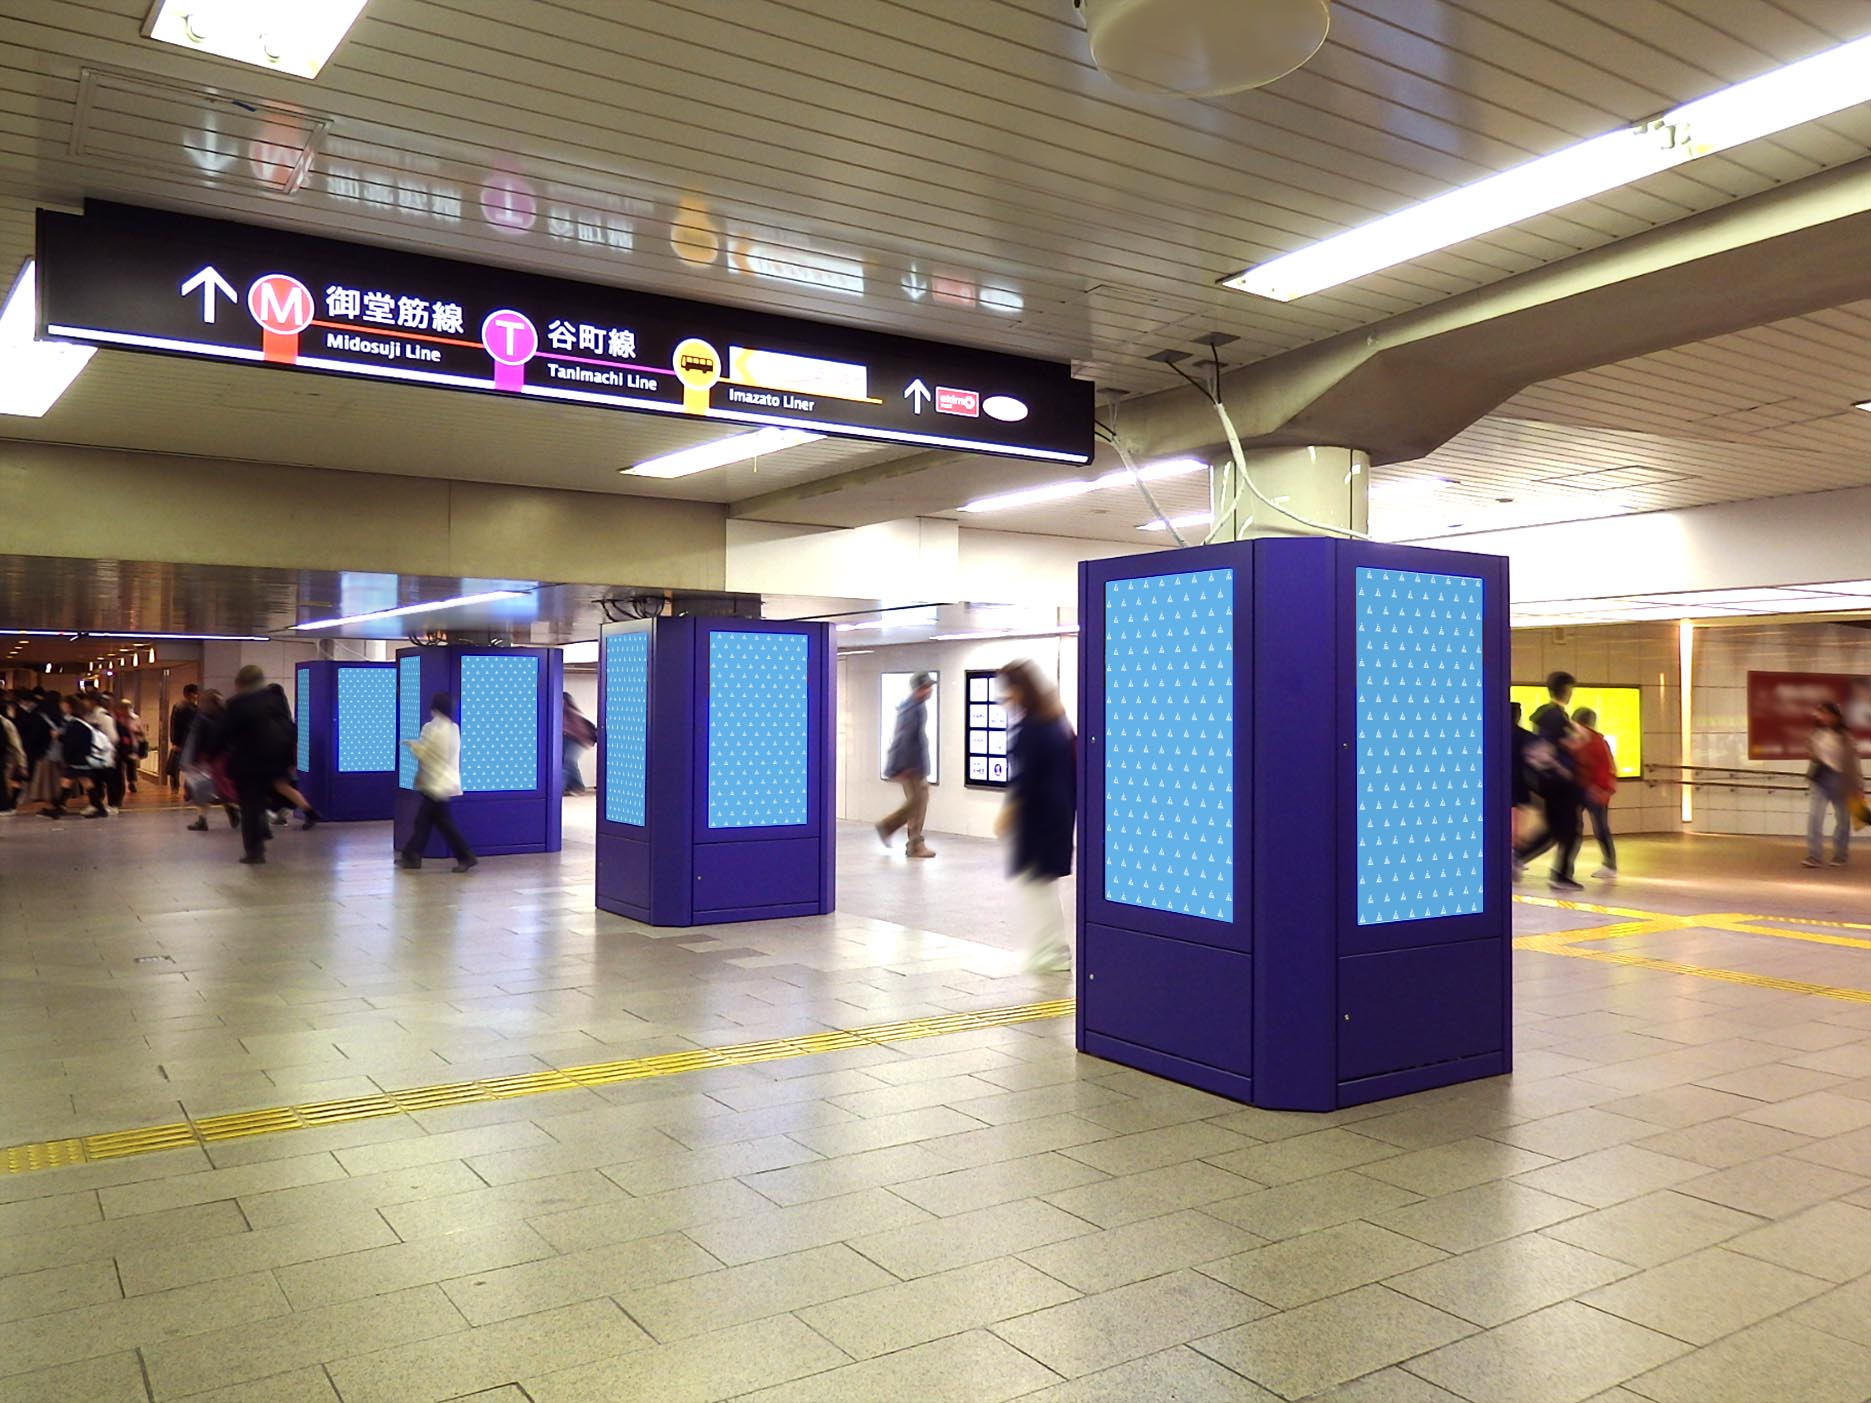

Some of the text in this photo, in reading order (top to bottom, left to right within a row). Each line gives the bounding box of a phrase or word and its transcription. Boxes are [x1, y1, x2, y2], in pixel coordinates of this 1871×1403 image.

[260, 282, 303, 326] M
[326, 285, 464, 334] 御堂筋線
[326, 333, 442, 362] Midosuji Line
[495, 319, 525, 356] T
[547, 319, 636, 359] 谷町線
[547, 363, 657, 391] Tanimachi Line
[729, 388, 815, 411] Imazato Liner
